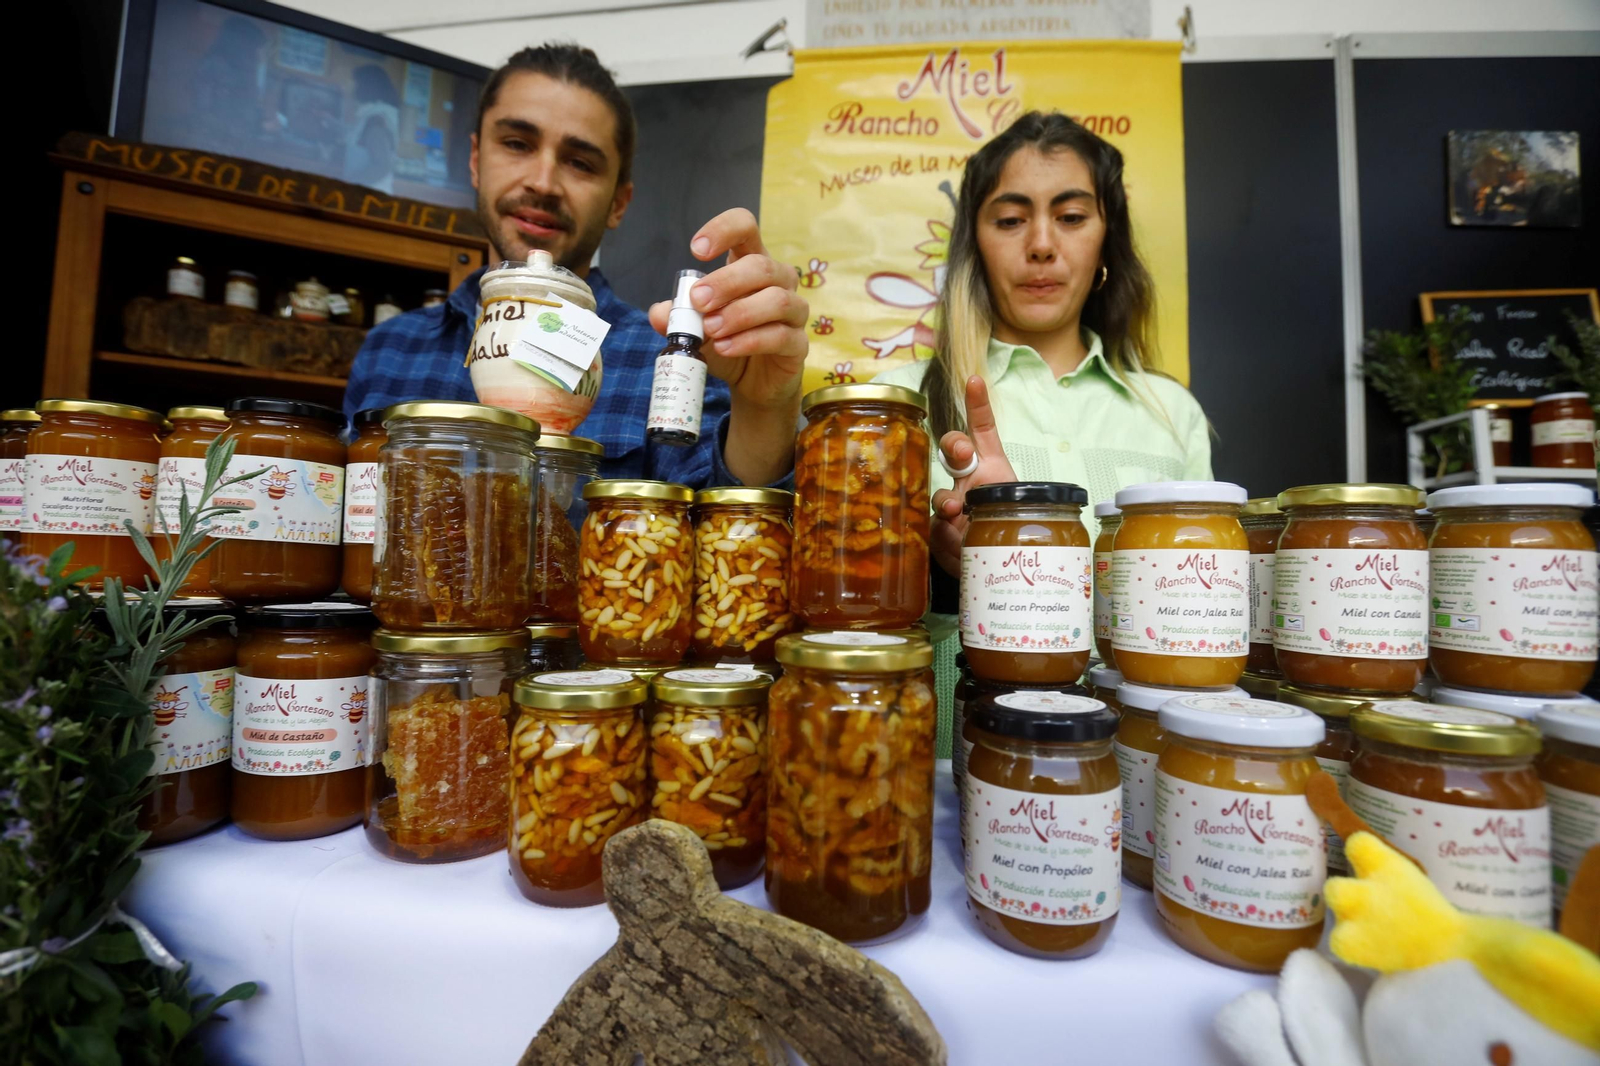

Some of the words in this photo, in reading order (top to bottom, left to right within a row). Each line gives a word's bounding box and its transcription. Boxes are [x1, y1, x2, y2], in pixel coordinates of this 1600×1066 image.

[897, 47, 1013, 139] Miel
[824, 101, 940, 137] Rancho
[86, 138, 243, 191] MUSEO
[256, 173, 298, 202] DE
[308, 183, 346, 211] LA
[818, 167, 884, 198] Museo
[890, 155, 915, 177] de
[920, 153, 940, 173] la
[568, 324, 598, 342] Natural
[41, 474, 73, 486] Rancho
[83, 474, 128, 491] Cortesano
[57, 459, 94, 486] Miel
[42, 503, 74, 511] Eucalipto
[1002, 550, 1041, 586] Miel
[1177, 553, 1218, 589] Miel
[1355, 553, 1399, 590] Miel
[1541, 554, 1583, 591] Miel
[984, 573, 1020, 588] Rancho
[1032, 569, 1074, 589] Cortesano
[1155, 575, 1196, 591] Rancho
[1330, 576, 1377, 592] Rancho
[1513, 577, 1563, 592] Rancho
[988, 602, 1006, 611] Miel
[1028, 603, 1069, 614] Propóleo
[1157, 607, 1179, 616] Miel
[1183, 608, 1201, 616] con
[1203, 608, 1227, 618] Jalea
[1341, 608, 1367, 618] Miel
[1394, 610, 1421, 619] Canela
[1522, 606, 1551, 615] Miel
[990, 621, 1032, 630] Producción
[1035, 622, 1069, 633] Ecológica
[1162, 625, 1209, 635] Producción
[1338, 626, 1390, 636] Producción
[1445, 632, 1463, 640] Origen
[1465, 634, 1490, 642] España
[245, 703, 276, 715] Rancho
[287, 700, 334, 718] Cortesano
[261, 683, 297, 716] Miel
[249, 731, 266, 741] Miel
[269, 733, 279, 741] de
[282, 732, 324, 741] Castaño
[247, 747, 284, 757] Producción
[287, 749, 325, 758] Ecológica
[1010, 799, 1057, 843] Miel
[1221, 798, 1274, 844] Miel
[988, 819, 1031, 835] Rancho
[1045, 823, 1100, 846] Cortesano
[1194, 819, 1245, 835] Rancho
[1262, 823, 1315, 847] Cortesano
[1473, 816, 1526, 863] Miel
[992, 854, 1015, 868] Miel
[1018, 863, 1039, 873] con
[1043, 864, 1093, 879] Propóleo
[1196, 855, 1223, 869] Miel
[1227, 864, 1250, 875] con
[1252, 868, 1286, 878] Jalea
[994, 876, 1044, 896] Producción
[1049, 889, 1091, 901] Ecológica
[1201, 878, 1261, 898] Producción
